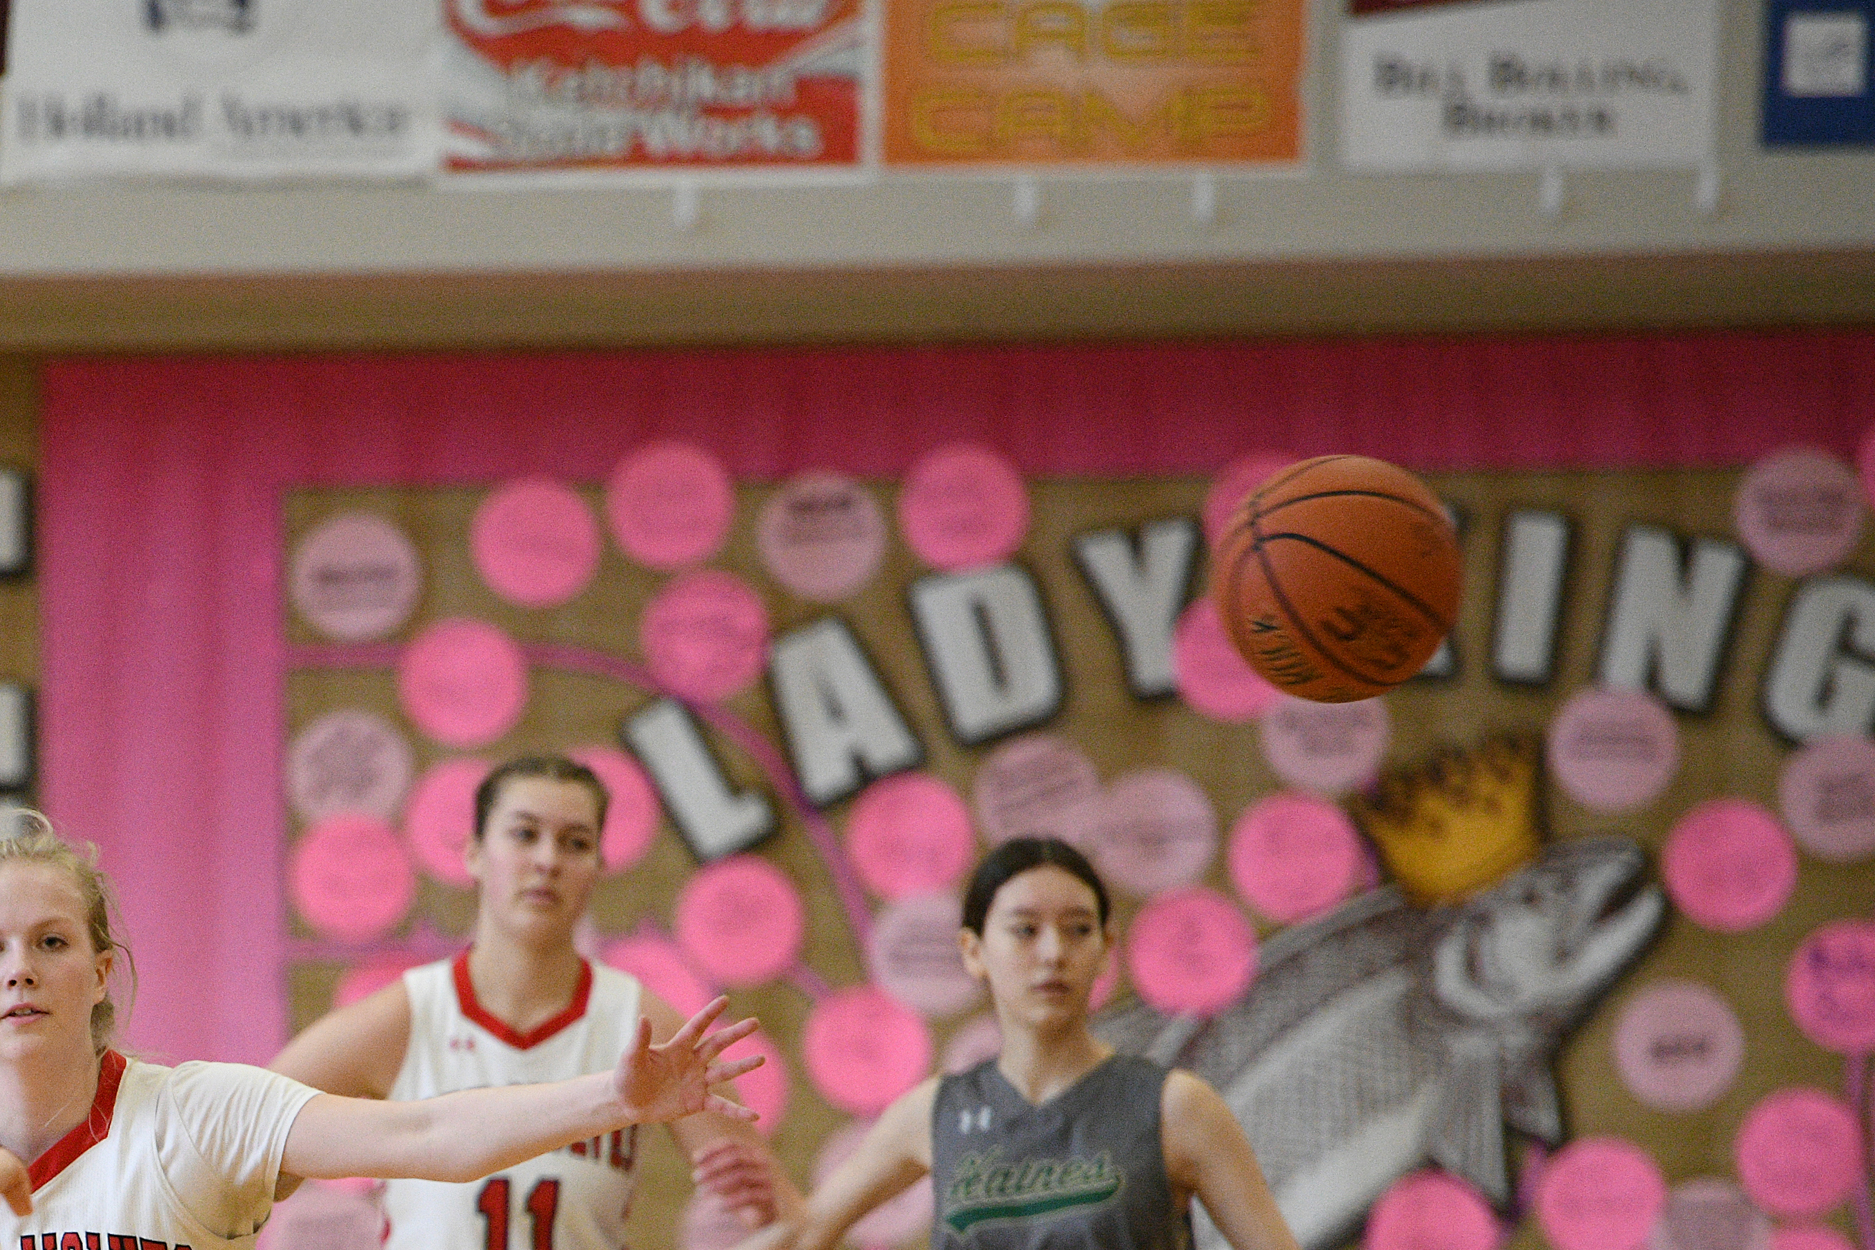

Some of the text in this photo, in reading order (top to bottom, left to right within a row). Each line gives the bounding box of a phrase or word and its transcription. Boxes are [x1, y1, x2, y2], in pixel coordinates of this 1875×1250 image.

[925, 2, 1263, 64] CAGE
[17, 92, 202, 138] Holland
[911, 84, 1271, 150] CAMP
[623, 512, 1205, 866] LADY
